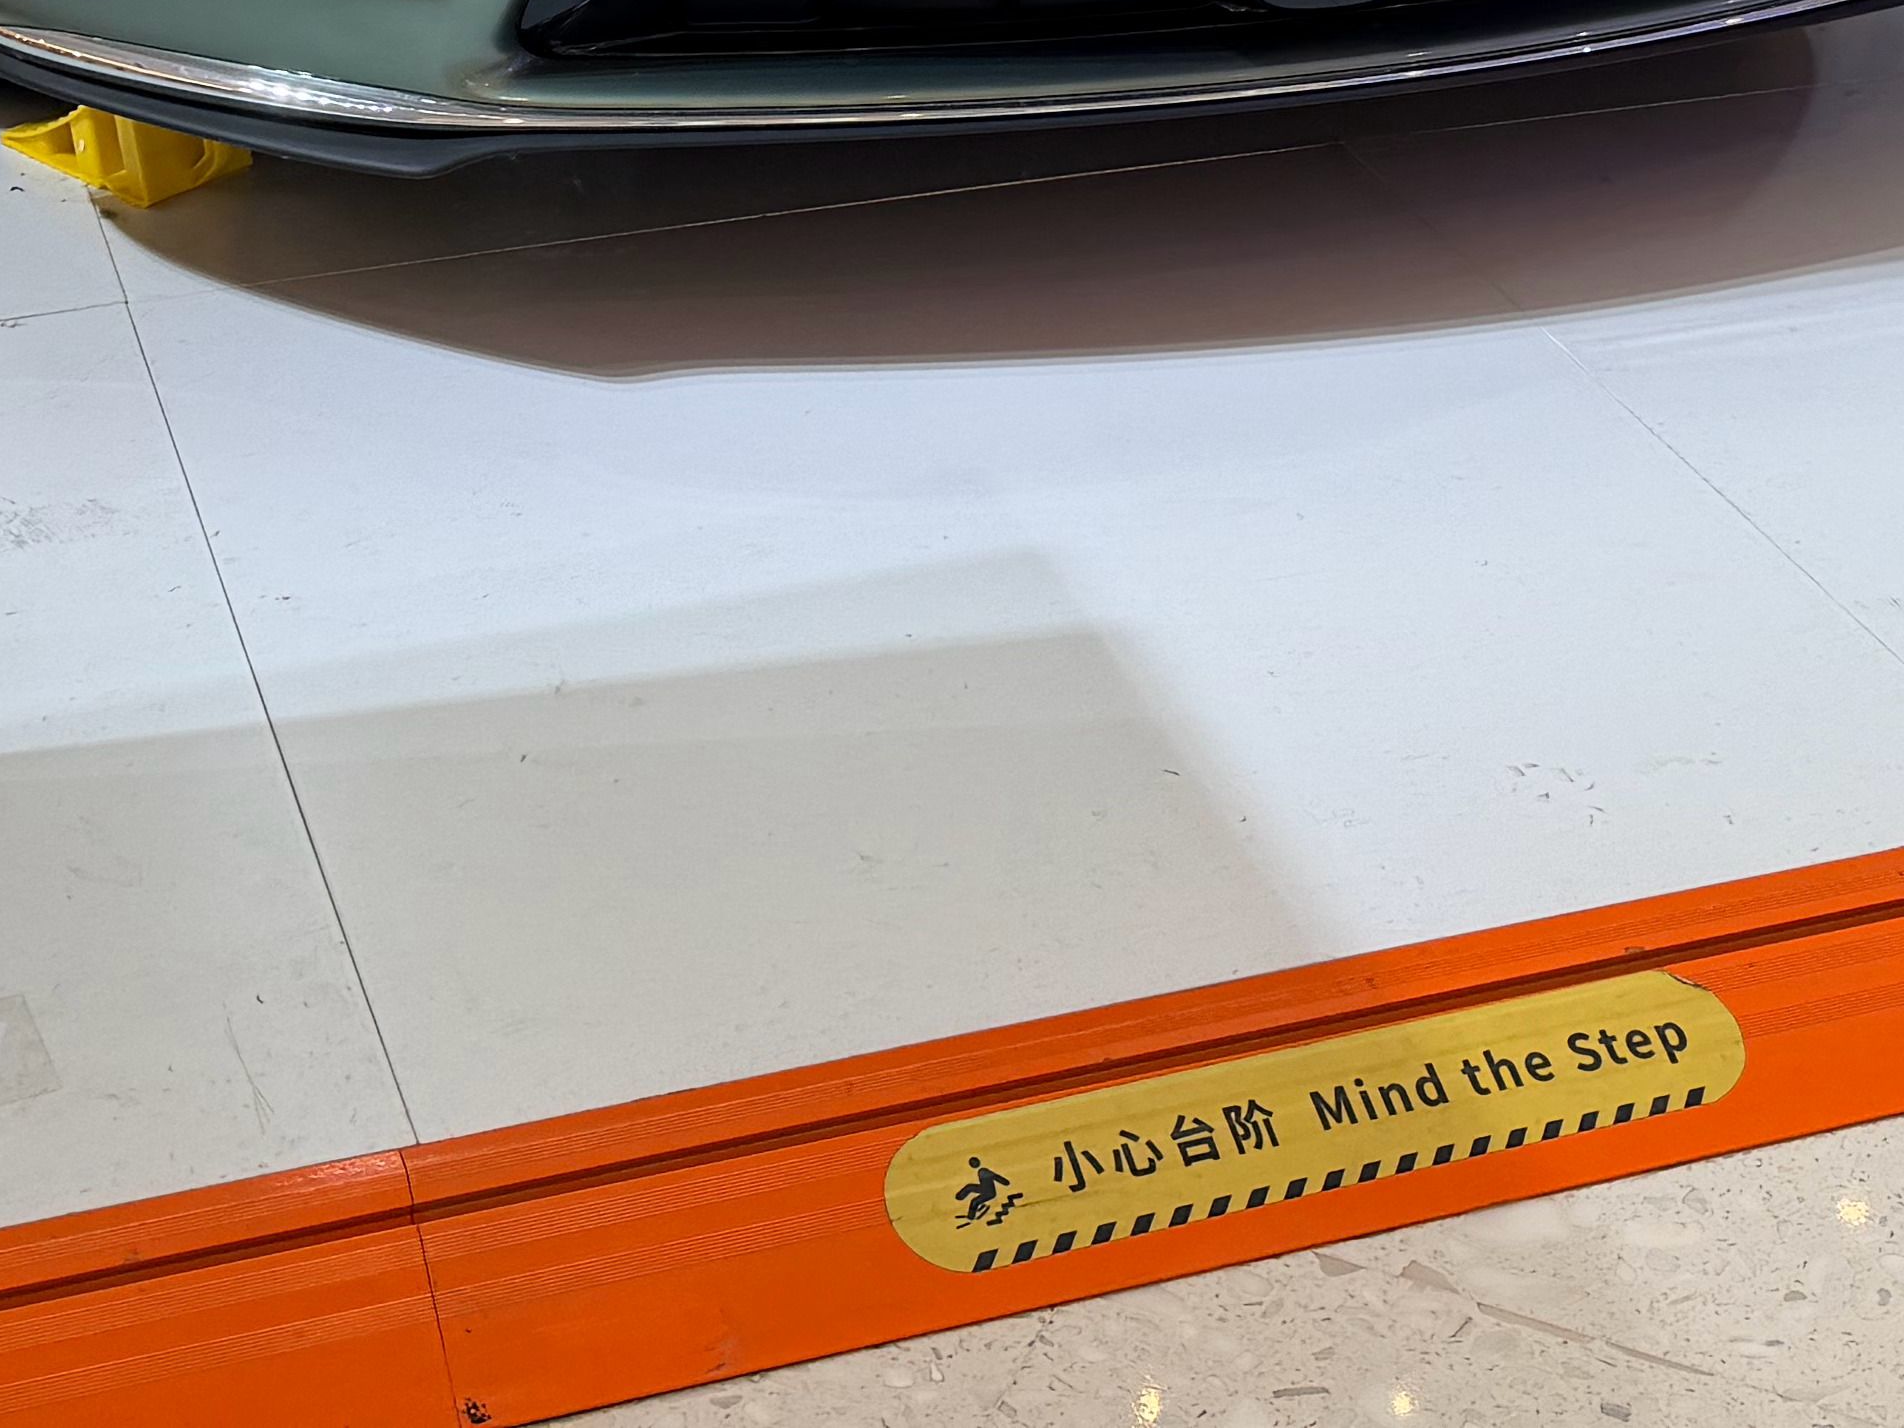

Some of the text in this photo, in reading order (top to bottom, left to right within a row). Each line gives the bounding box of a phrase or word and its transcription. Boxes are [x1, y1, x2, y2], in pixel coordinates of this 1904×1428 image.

[1052, 1013, 1690, 1194] 小心台阶 Mind the Step
